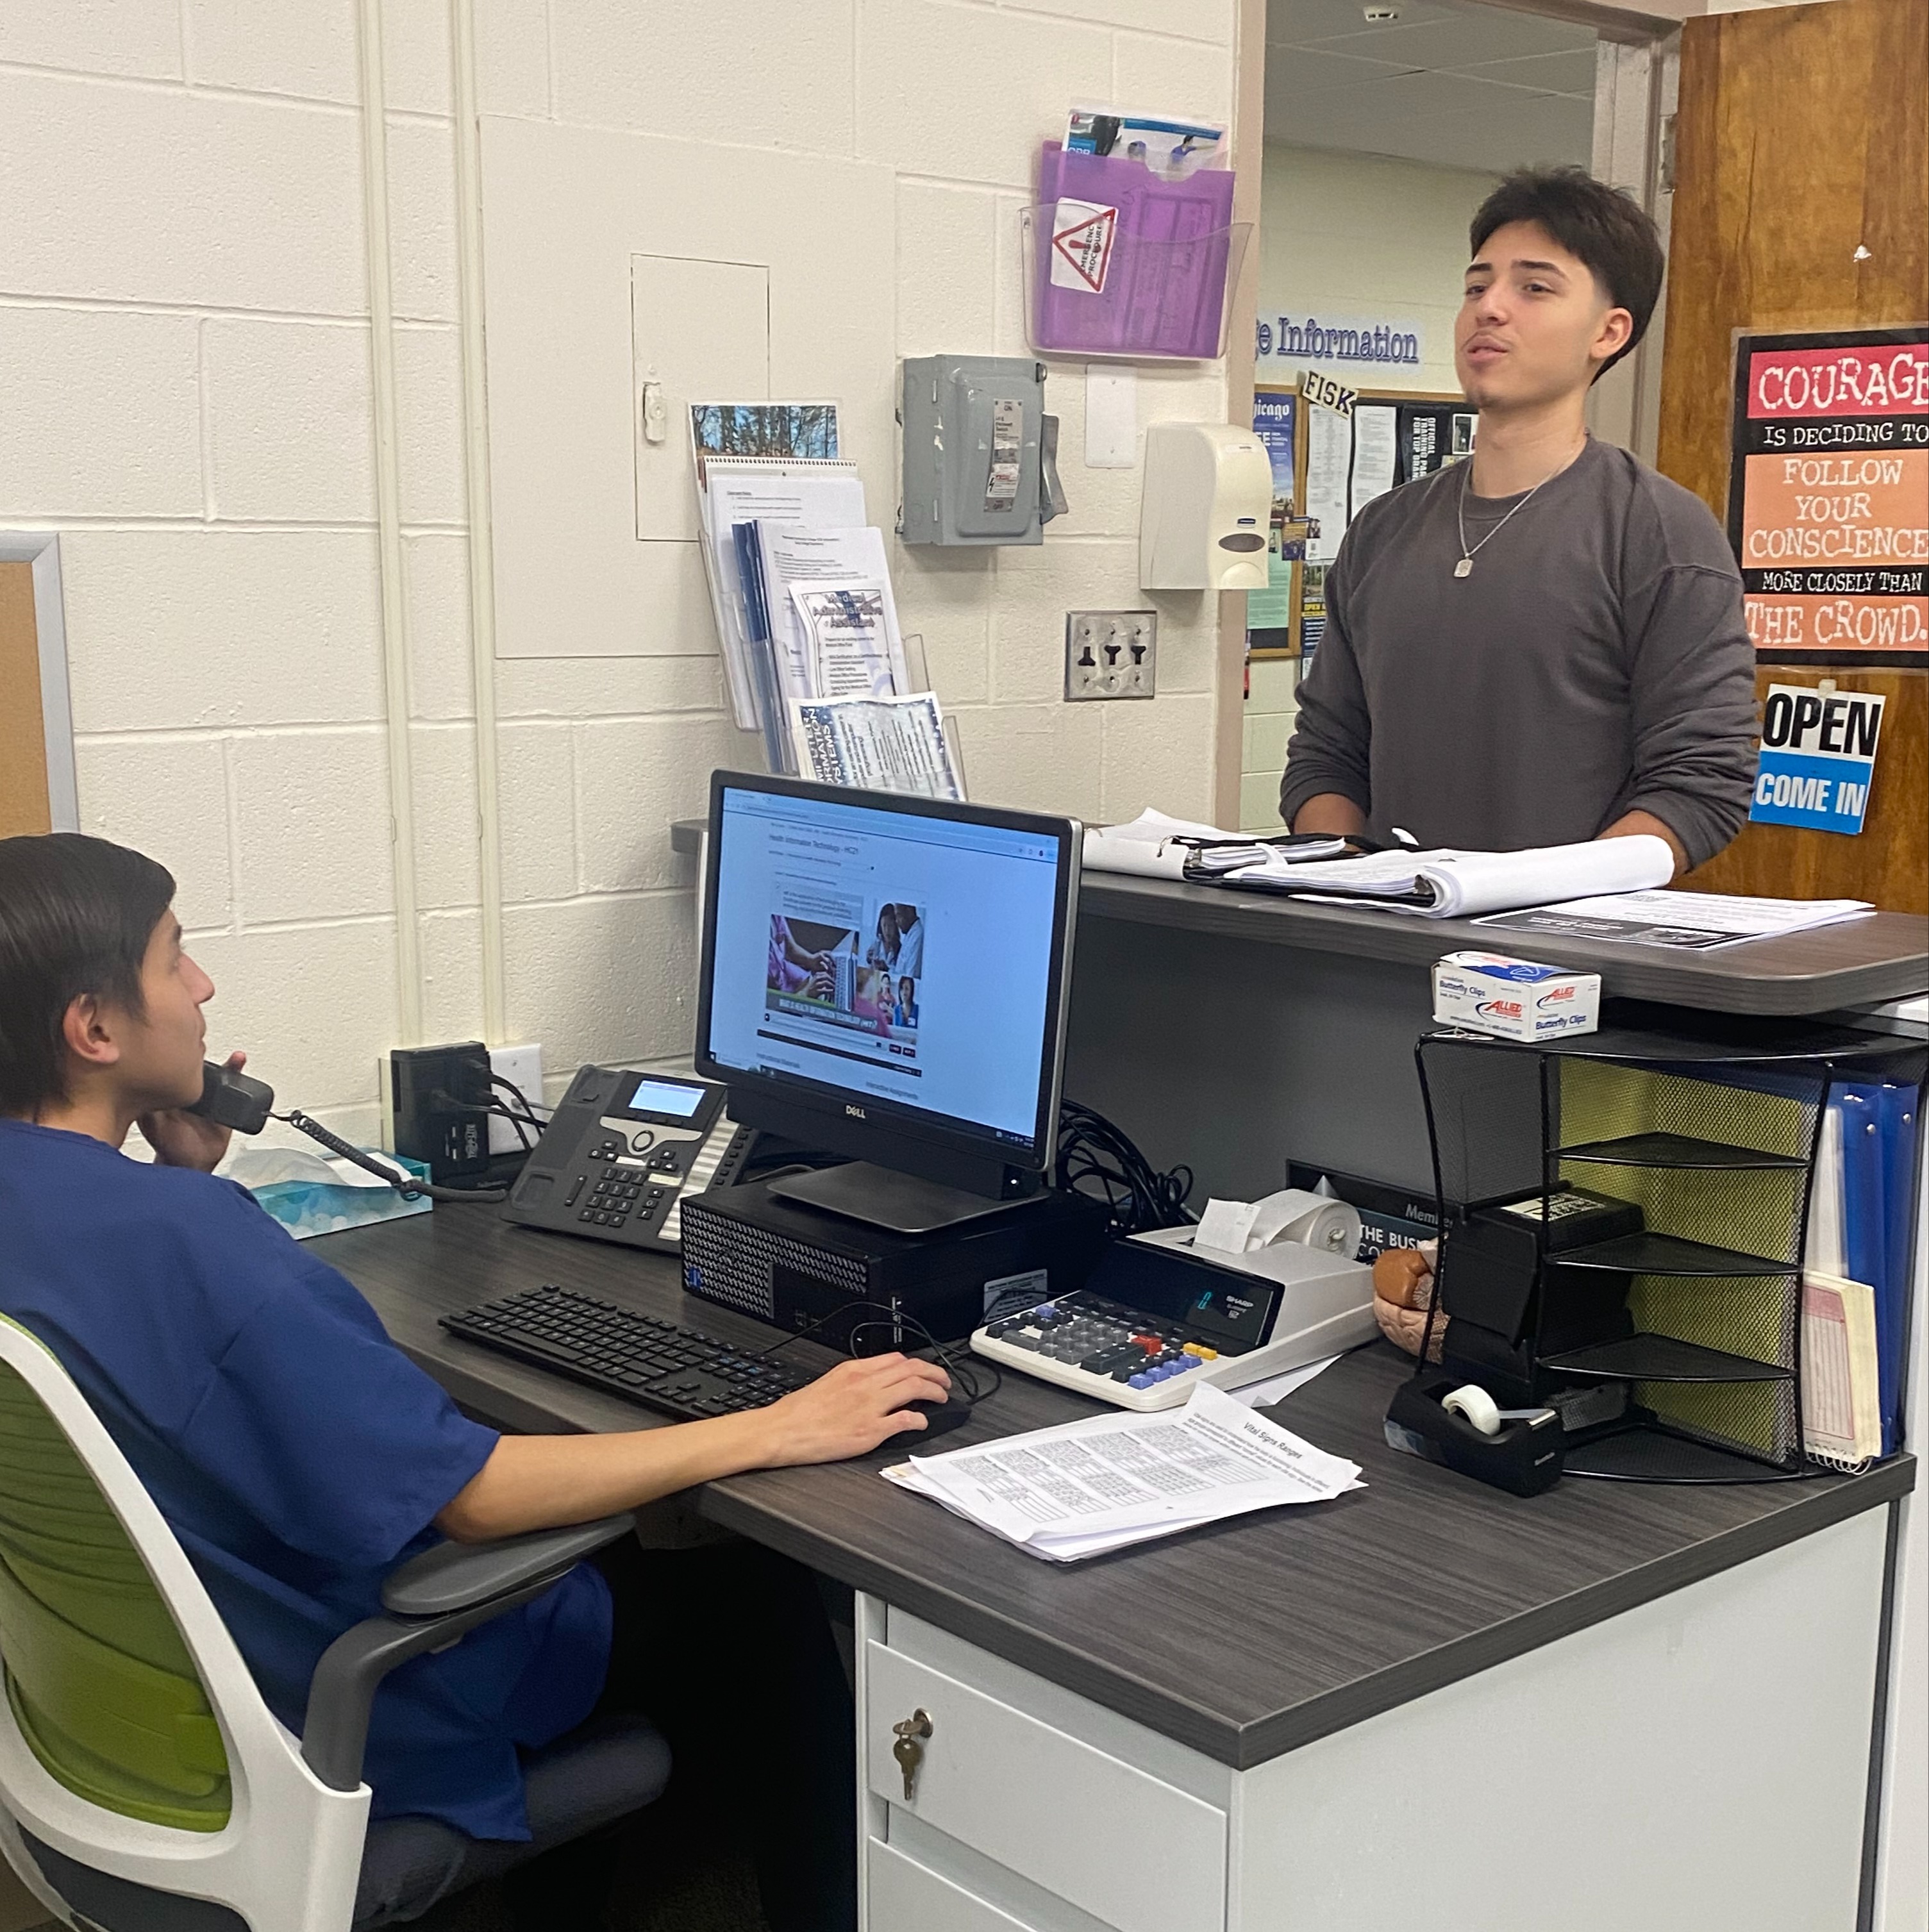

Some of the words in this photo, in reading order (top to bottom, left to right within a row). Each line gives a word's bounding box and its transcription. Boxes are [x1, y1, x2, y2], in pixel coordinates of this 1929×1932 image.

[1277, 317, 1419, 363] Information
[1305, 371, 1355, 415] FISK
[1758, 353, 1928, 410] COURAGE
[1420, 418, 1428, 458] TRAINING
[1763, 426, 1786, 446] IS
[1793, 422, 1894, 445] DECIDING
[1901, 423, 1928, 442] TO
[1782, 459, 1903, 485] FOLLOW
[1795, 492, 1872, 522] YOUR
[1749, 525, 1928, 558] CONSCIENCE
[1762, 571, 1803, 592] MORE
[1807, 572, 1876, 592] CLOSELY
[1879, 572, 1923, 592] THAN
[1744, 602, 1803, 644] THE
[1814, 599, 1928, 645] CROWD.
[1763, 693, 1881, 756] OPEN
[1756, 772, 1832, 812] COME
[1835, 782, 1866, 817] IN
[1440, 980, 1468, 994] Butterfly
[1469, 987, 1486, 999] Clips
[1544, 987, 1576, 1002] ALLIED
[1484, 1000, 1523, 1013] ALLIED
[1535, 1017, 1567, 1031] Butterfly
[1569, 1014, 1587, 1026] Clips
[846, 1105, 866, 1119] DELL
[1359, 1224, 1384, 1244] THE
[1389, 1232, 1419, 1251] BUS
[1226, 1295, 1254, 1308] SHARP
[1243, 1422, 1260, 1436] Vital
[1258, 1431, 1278, 1447] Signs
[1276, 1442, 1303, 1460] Ranges
